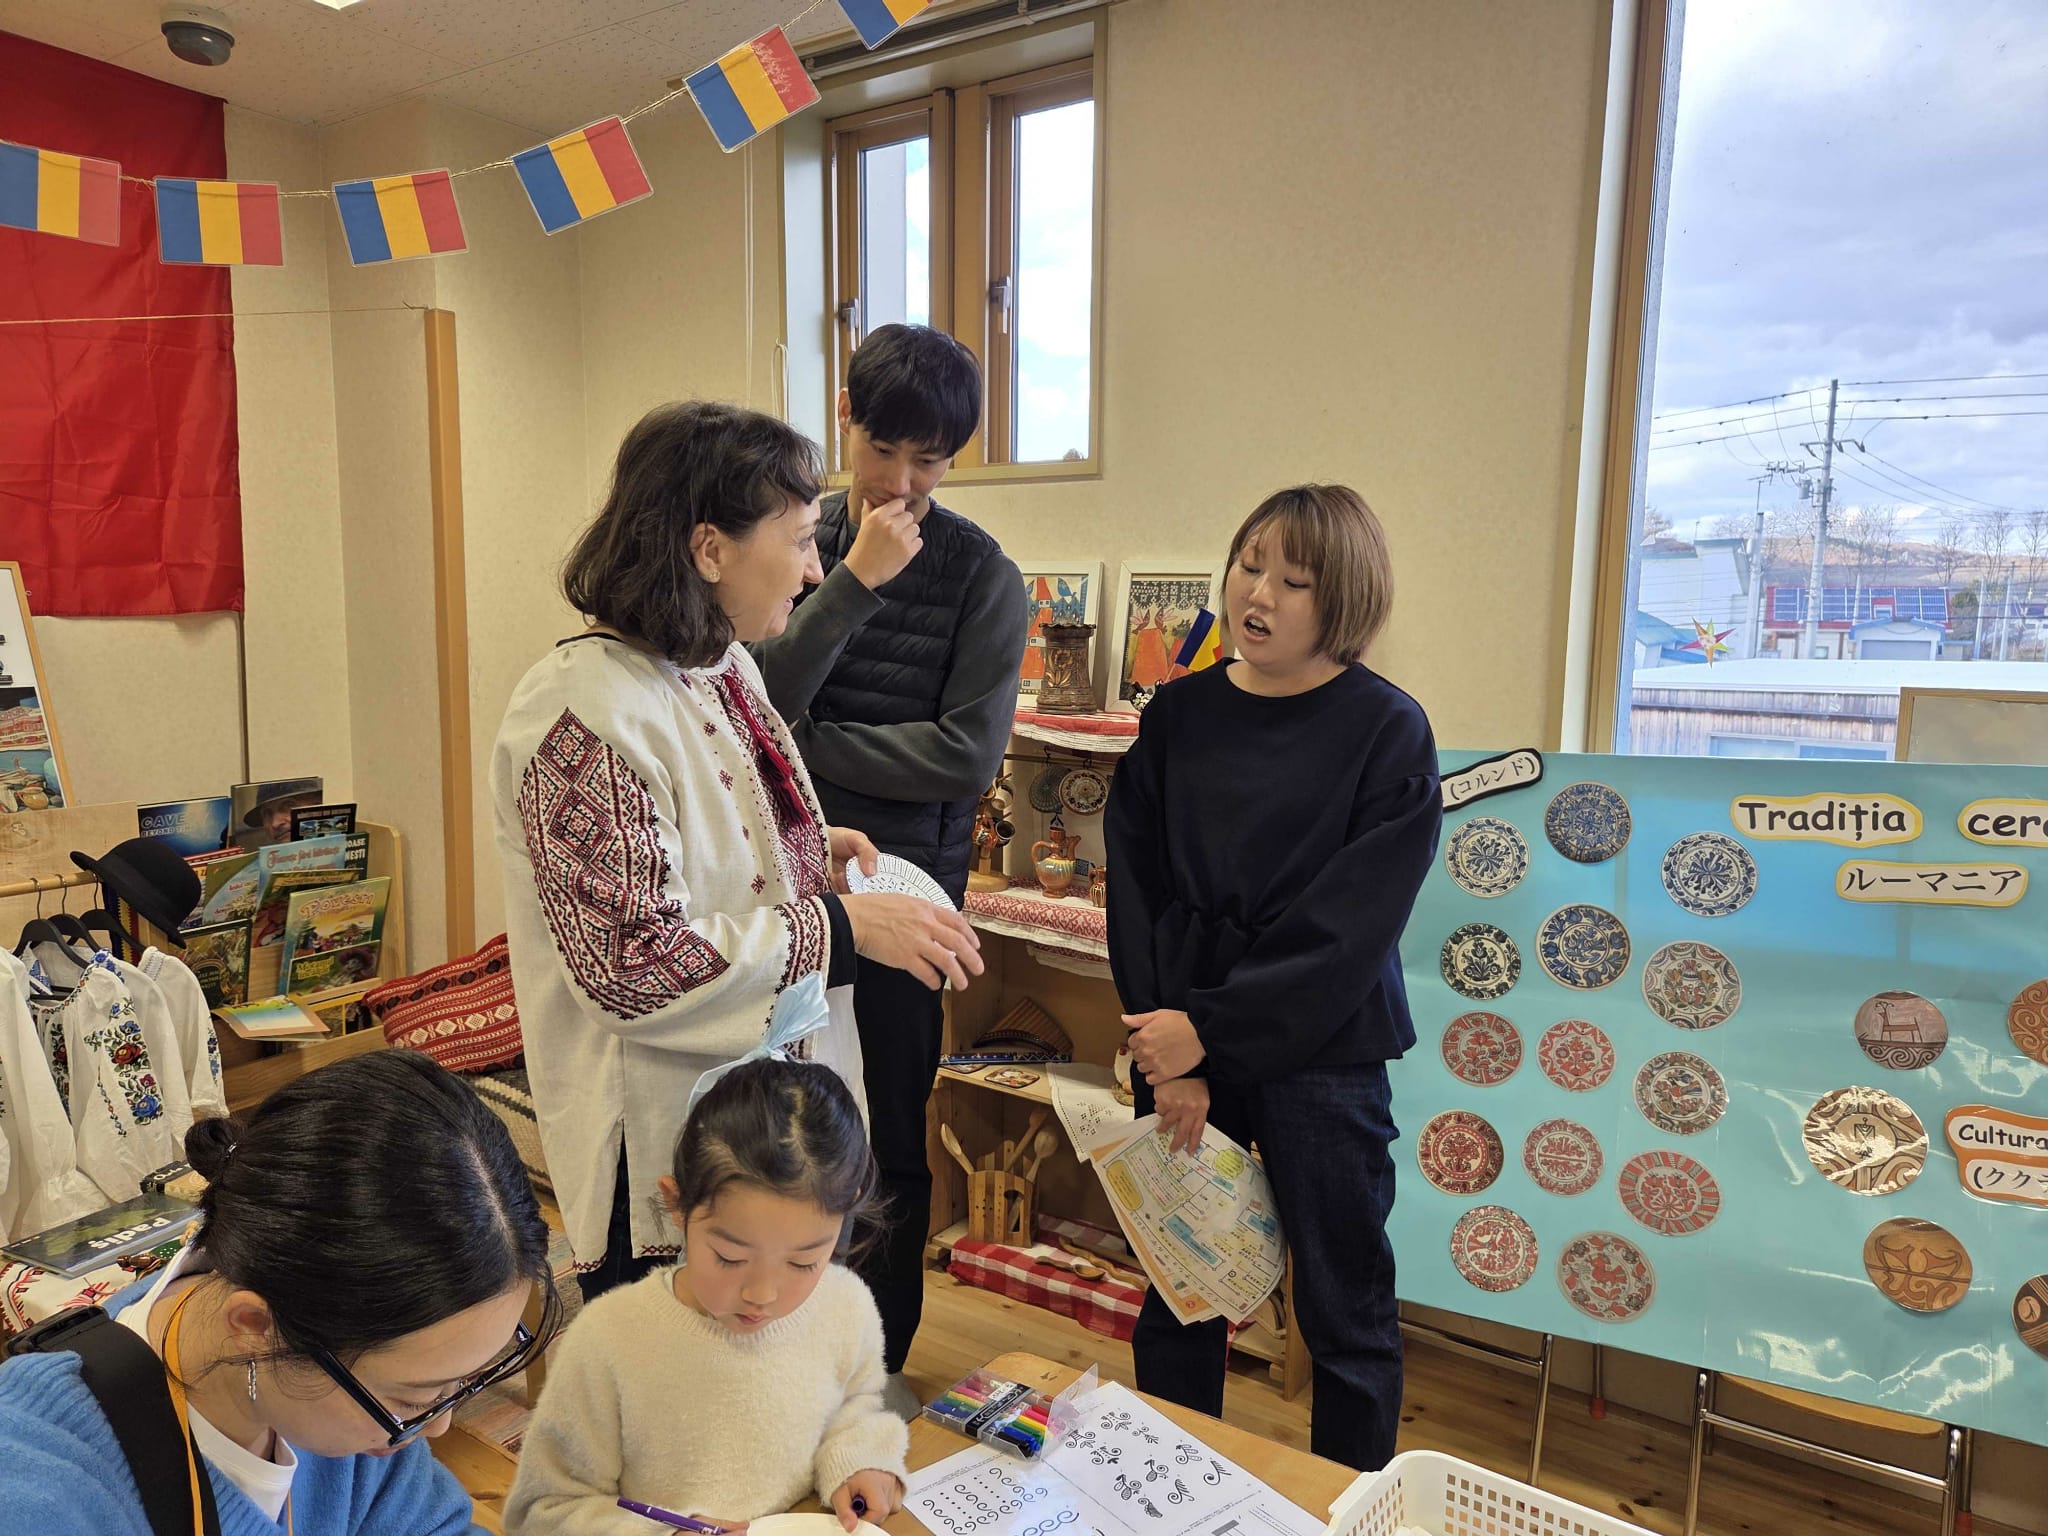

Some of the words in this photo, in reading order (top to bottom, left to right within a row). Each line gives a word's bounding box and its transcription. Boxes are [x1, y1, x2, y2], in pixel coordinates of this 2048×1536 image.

[1450, 756, 1536, 801] (コルンド)
[1738, 800, 1907, 841] Tradiția
[1967, 812, 2048, 838] cer
[1842, 866, 2022, 897] ルーマニア
